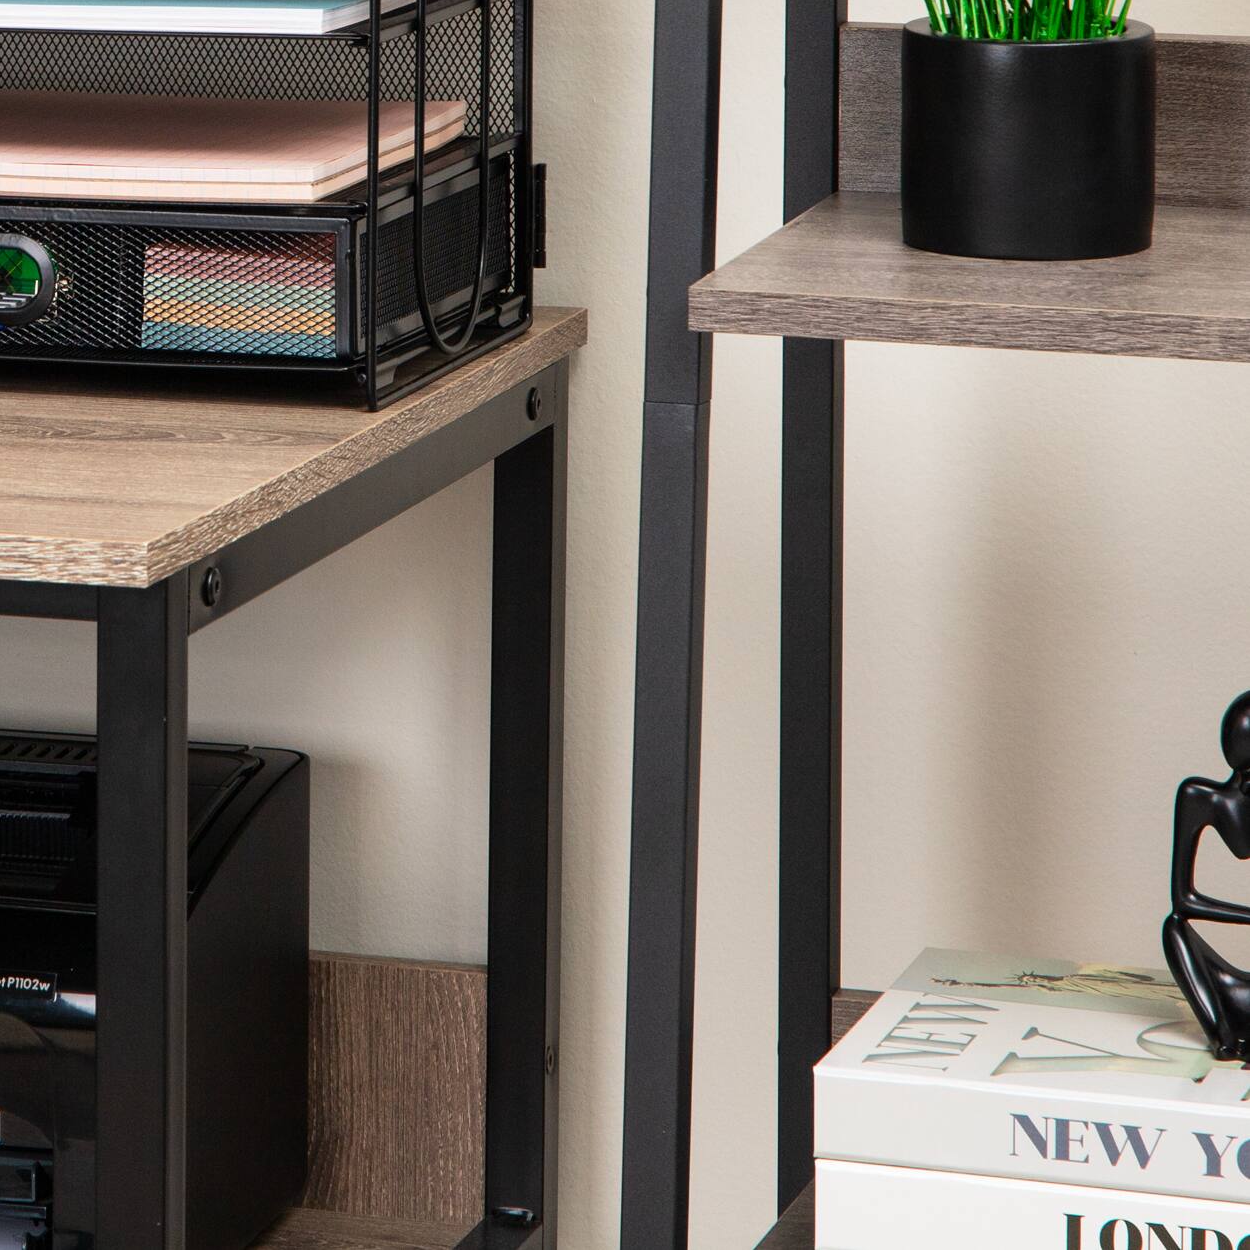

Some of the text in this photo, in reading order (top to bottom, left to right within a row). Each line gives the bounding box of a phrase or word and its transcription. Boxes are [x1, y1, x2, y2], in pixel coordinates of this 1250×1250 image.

[7, 976, 51, 991] P1102w
[862, 992, 1000, 1072] NEW
[1009, 1113, 1250, 1180] NEW Y
[1063, 1213, 1250, 1250] LOND
